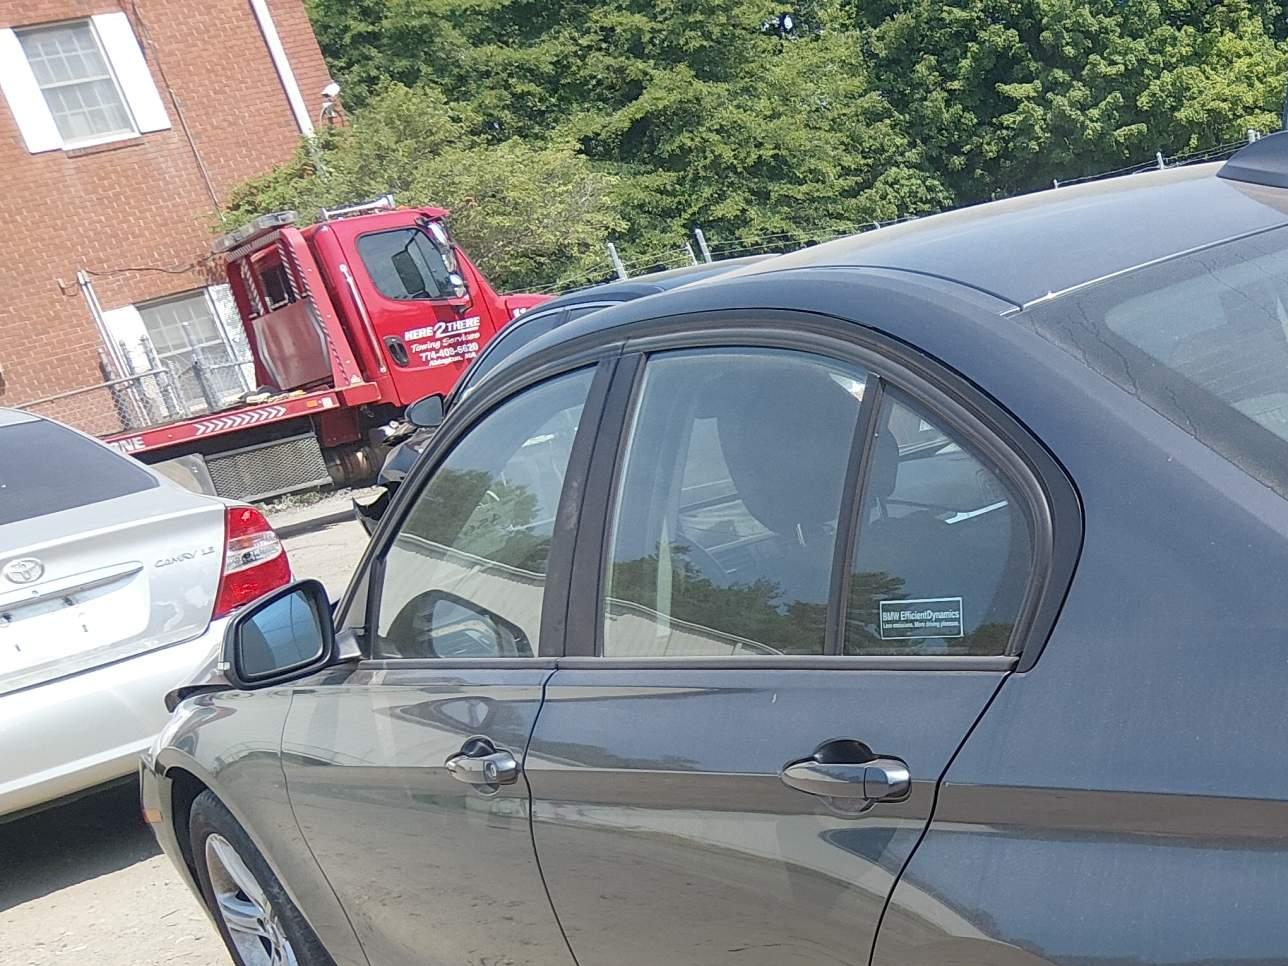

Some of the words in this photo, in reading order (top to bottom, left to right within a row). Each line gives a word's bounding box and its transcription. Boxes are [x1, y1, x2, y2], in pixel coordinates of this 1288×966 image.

[405, 327, 433, 341] HERE
[434, 322, 446, 339] 2
[447, 316, 480, 332] THERE
[411, 341, 441, 353] Towing
[442, 332, 480, 346] Services
[883, 611, 900, 621] BMW
[900, 608, 960, 621] EfficientDynamics
